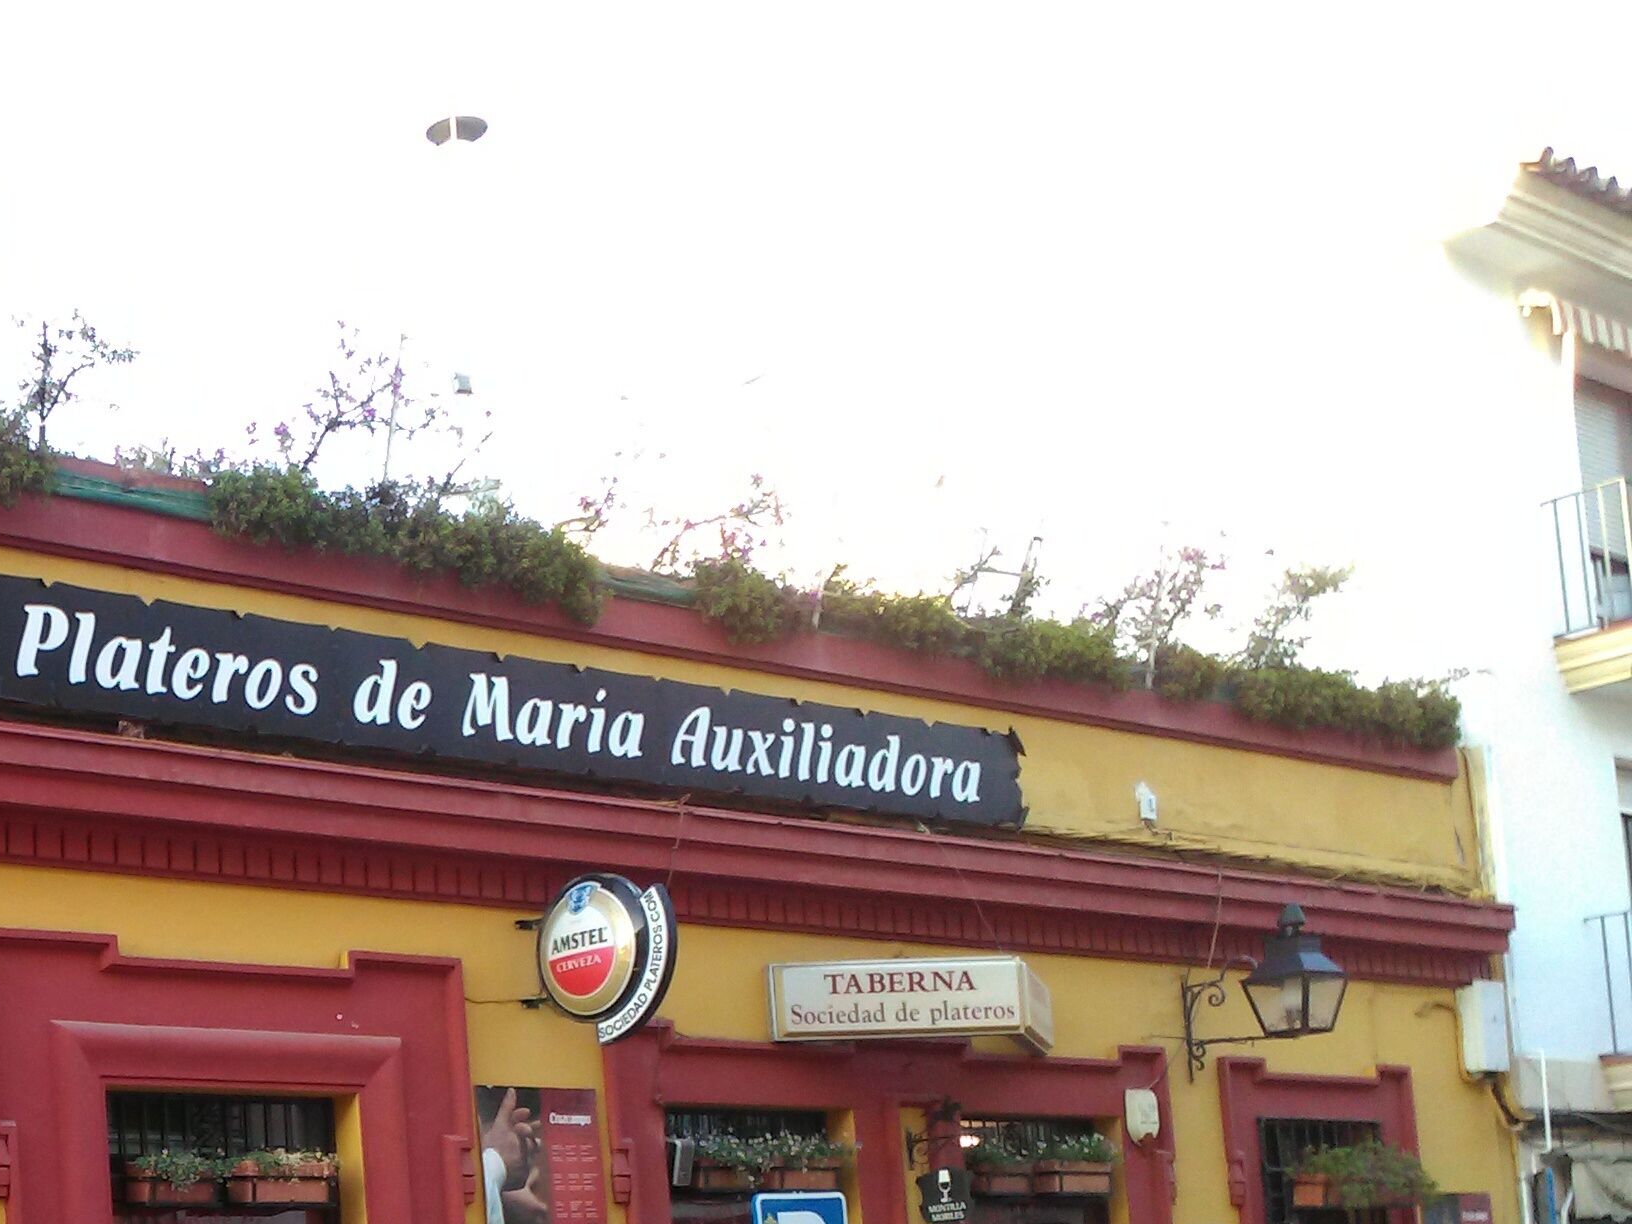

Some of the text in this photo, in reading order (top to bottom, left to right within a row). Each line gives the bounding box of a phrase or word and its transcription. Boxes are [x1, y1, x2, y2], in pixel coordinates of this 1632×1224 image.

[16, 604, 319, 715] Plateros
[353, 658, 432, 730] de
[671, 706, 981, 803] Auxiliadora
[551, 927, 608, 955] AMSTEL
[556, 955, 601, 972] CERVEZA
[598, 993, 648, 1039] SOCIEDAD
[644, 925, 664, 991] PLATEROS
[823, 969, 977, 995] TABERNA
[790, 1000, 1015, 1026] Sociedad de plateros
[928, 1201, 967, 1213] MONTILLA
